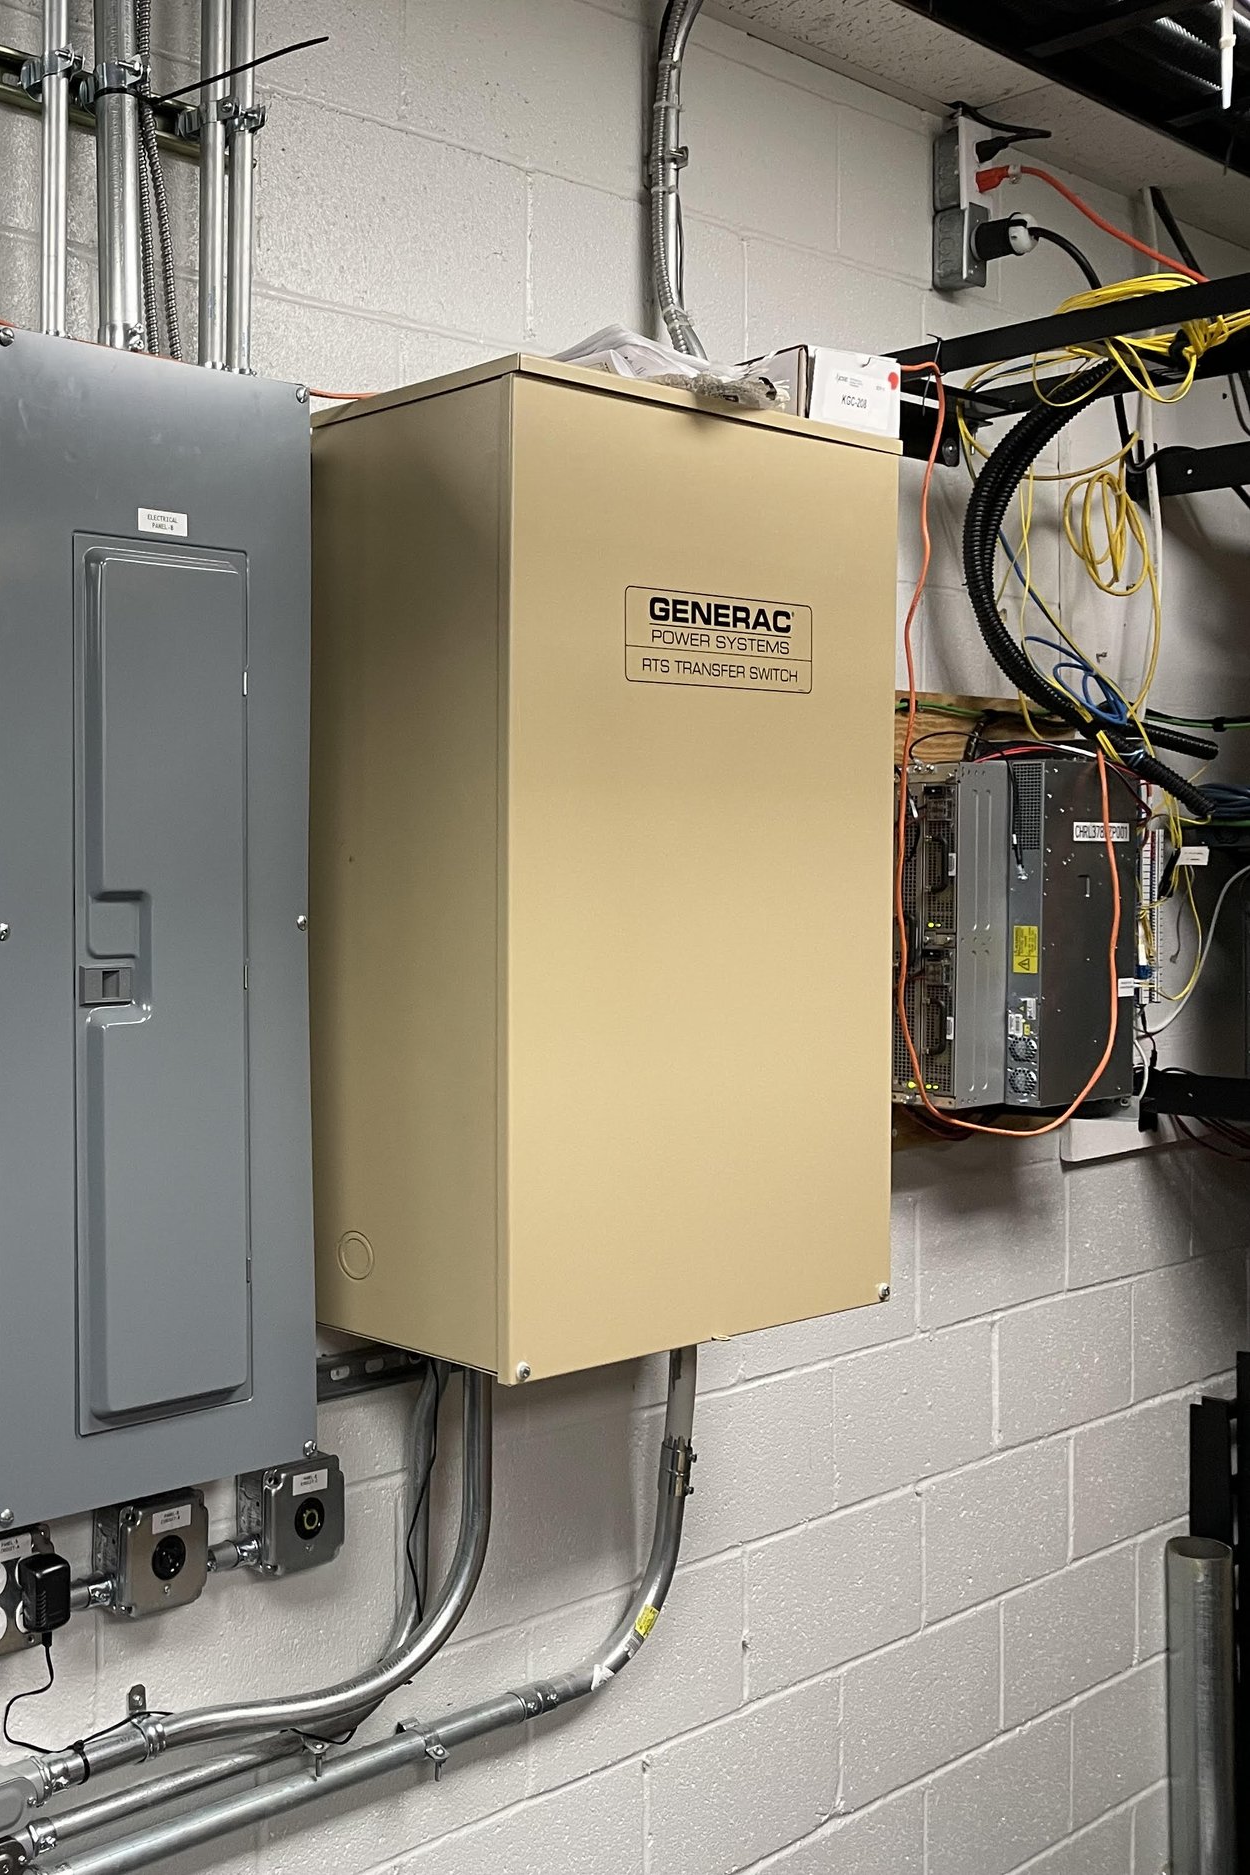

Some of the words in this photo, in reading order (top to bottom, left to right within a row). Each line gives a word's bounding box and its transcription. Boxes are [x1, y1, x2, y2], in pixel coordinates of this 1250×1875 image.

[147, 513, 178, 524] ELECTRICAL
[151, 522, 174, 531] PANEL-B
[649, 596, 792, 634] GENERAC
[651, 629, 711, 648] POWER
[715, 635, 791, 655] SYSTEMS
[641, 657, 671, 674] RTS
[674, 660, 746, 679] TRANSFER
[749, 667, 799, 683] SWITCH
